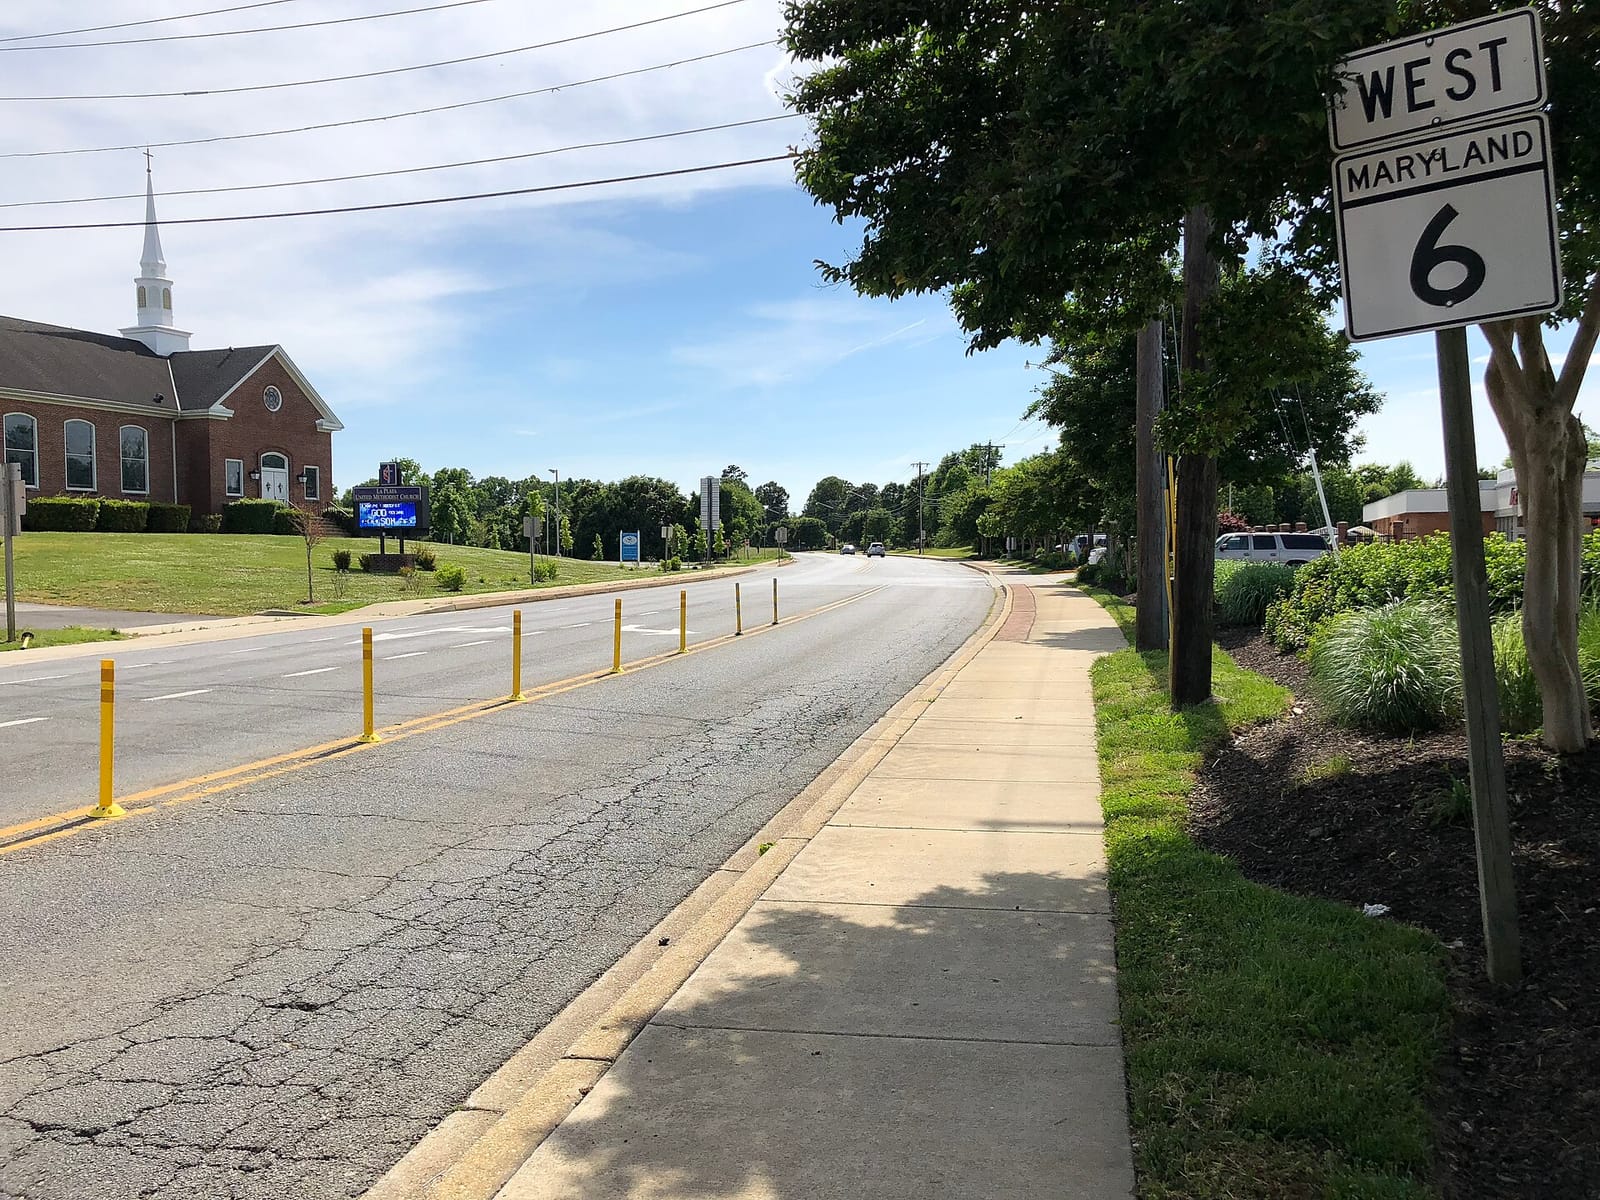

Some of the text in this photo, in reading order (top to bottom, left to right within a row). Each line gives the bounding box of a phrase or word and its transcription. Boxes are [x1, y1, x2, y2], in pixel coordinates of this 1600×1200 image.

[1356, 37, 1507, 123] WEST
[1347, 130, 1533, 193] MARYLAND
[1410, 203, 1486, 307] 6
